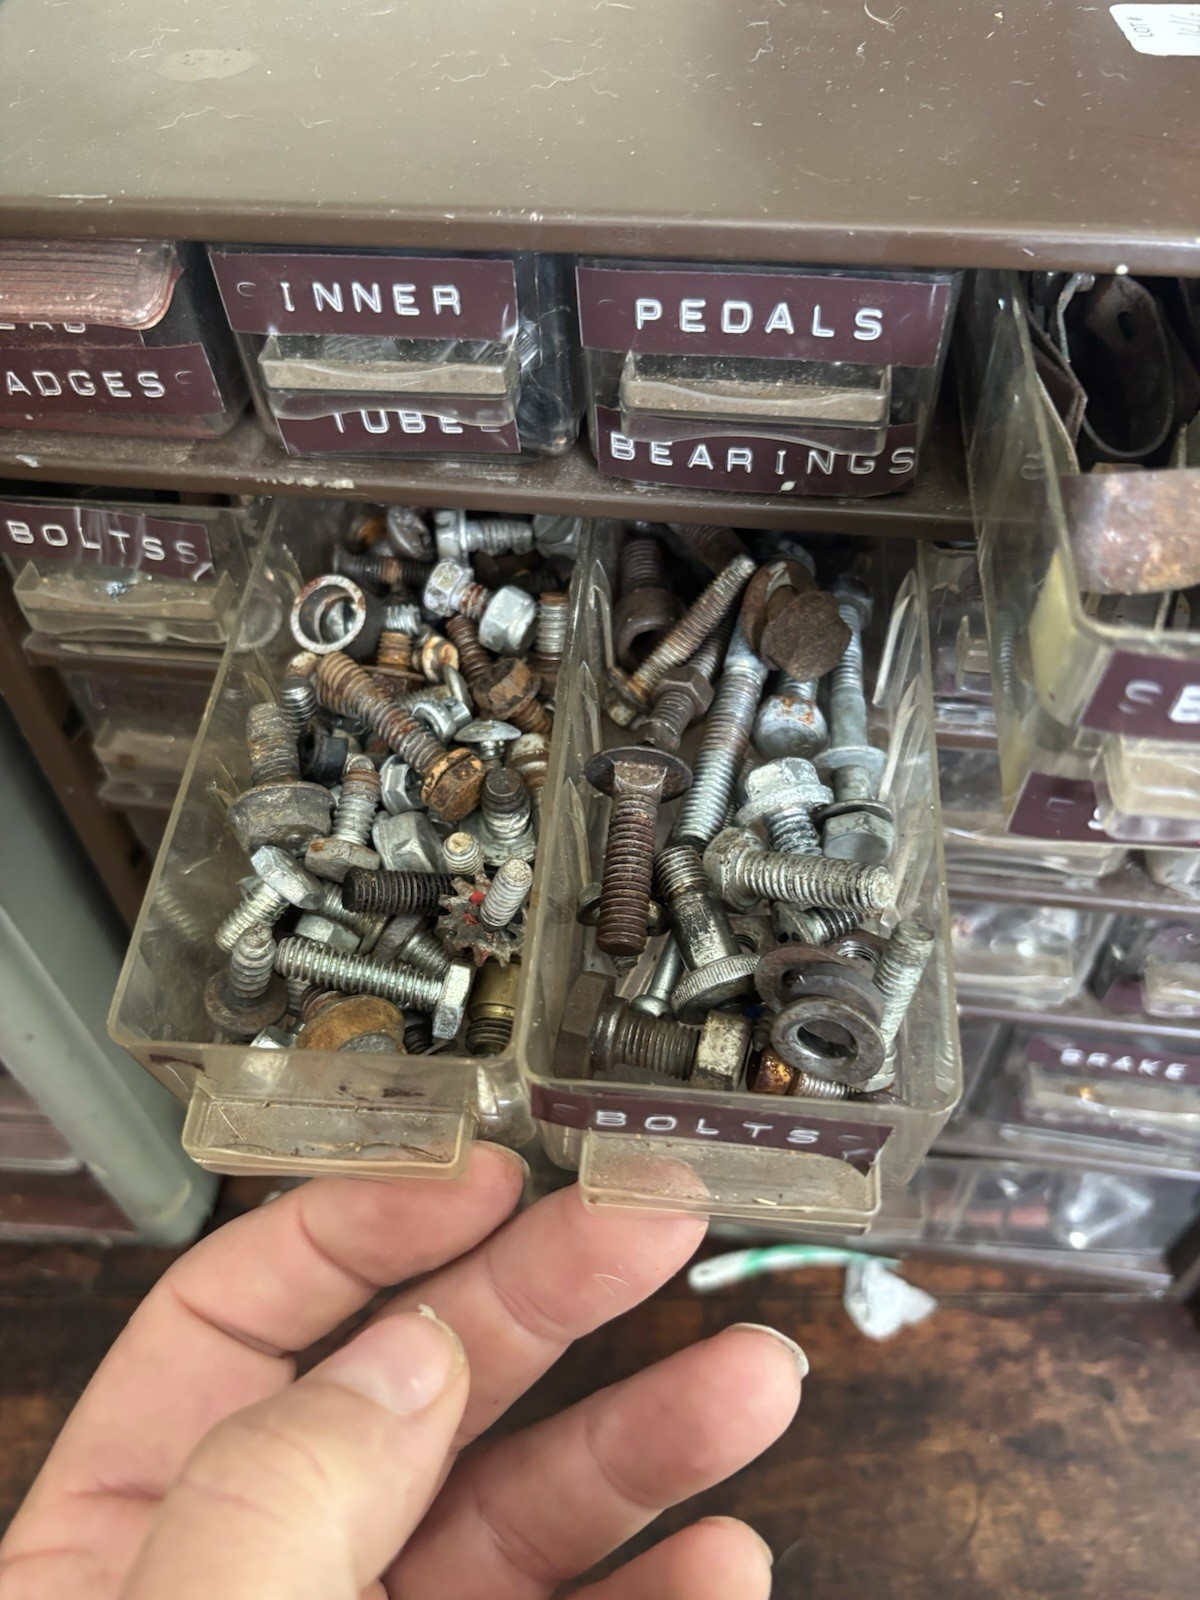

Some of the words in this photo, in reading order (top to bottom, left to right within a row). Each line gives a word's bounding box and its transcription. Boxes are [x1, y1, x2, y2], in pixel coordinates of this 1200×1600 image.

[279, 281, 462, 316] INNER
[635, 298, 884, 341] PEDALS
[6, 370, 166, 398] ADGES
[333, 409, 502, 434] UBE
[610, 431, 915, 476] BEARINGS
[596, 1110, 820, 1144] BOLTS
